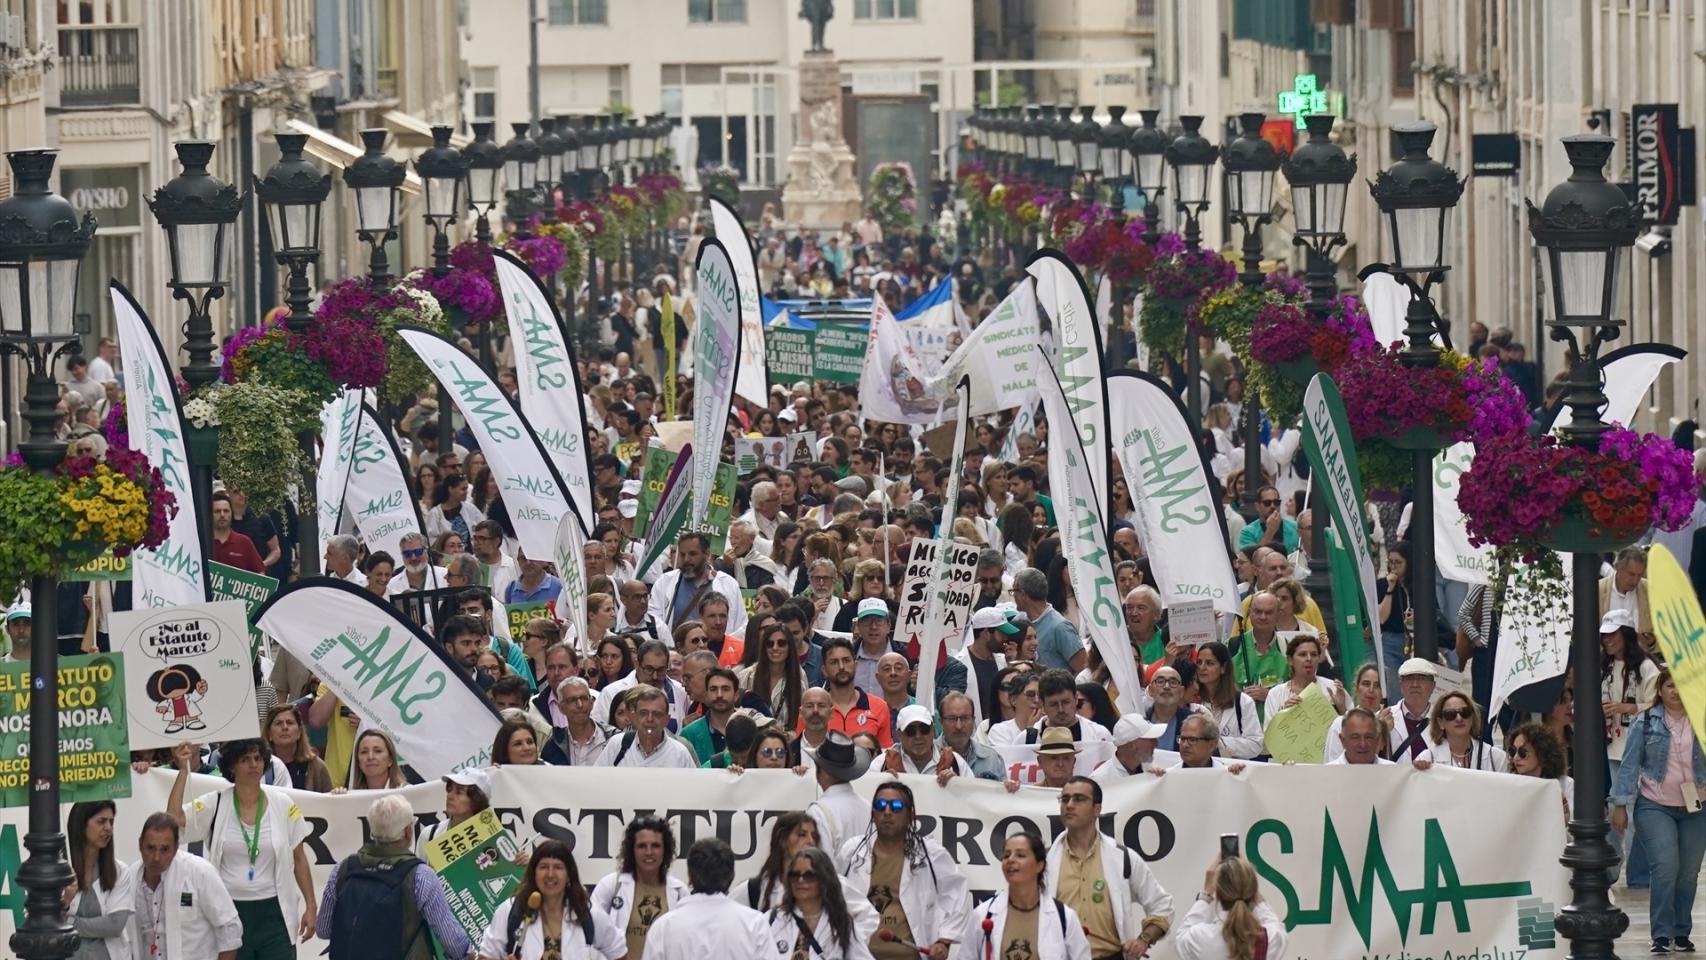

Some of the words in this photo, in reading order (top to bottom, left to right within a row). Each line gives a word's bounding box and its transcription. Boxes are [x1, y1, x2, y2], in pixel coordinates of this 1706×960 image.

[1637, 111, 1658, 220] PRIMOR
[71, 186, 129, 210] OYSHO
[185, 621, 199, 631] al
[150, 632, 211, 646] Estatuto
[156, 642, 206, 657] Marco!
[1246, 805, 1532, 952] SMA
